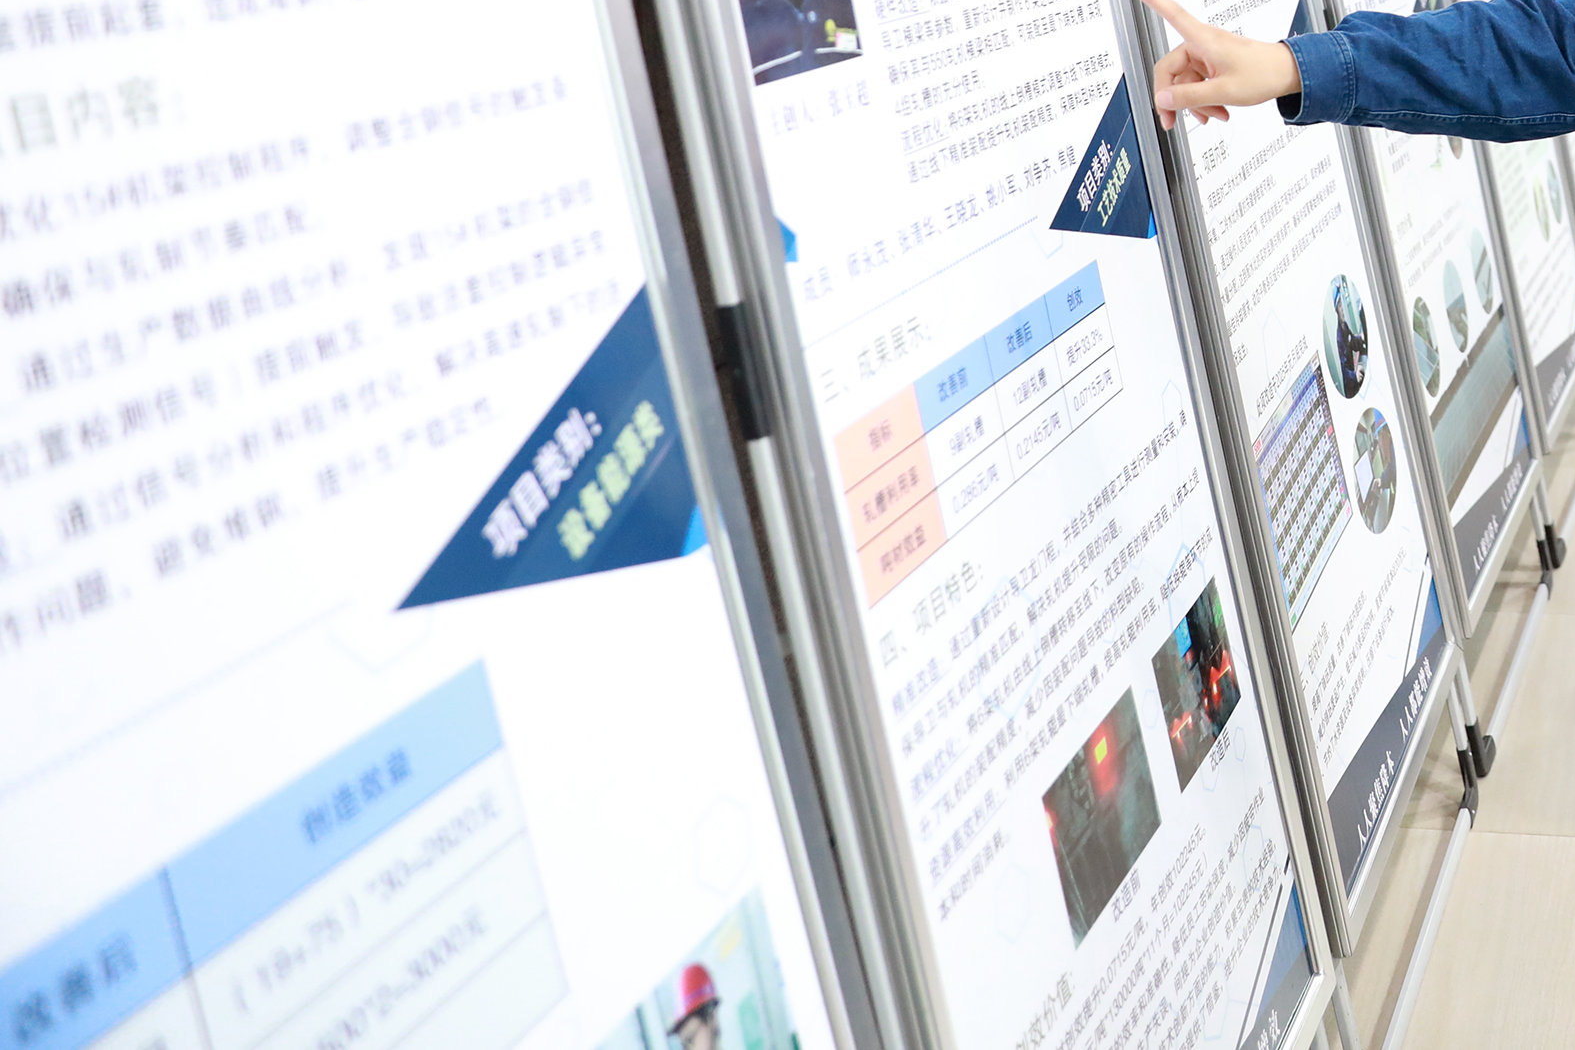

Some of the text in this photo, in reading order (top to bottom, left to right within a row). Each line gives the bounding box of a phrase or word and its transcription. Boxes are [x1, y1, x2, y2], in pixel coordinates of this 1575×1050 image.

[1076, 139, 1114, 212] 项目类别：
[1191, 139, 1231, 181] 、项目内容：
[1065, 285, 1085, 314] 创效
[1005, 319, 1035, 355] 改善后
[936, 365, 969, 403] 改善前
[1072, 365, 1115, 413] 0.0715元/吨
[1015, 410, 1064, 461] 0.2145元/吨
[951, 461, 1001, 516] 0.286元/吨
[1208, 727, 1232, 772] 改造后
[1357, 750, 1395, 850] 人人聚焦降本
[1110, 867, 1142, 923] 改造前
